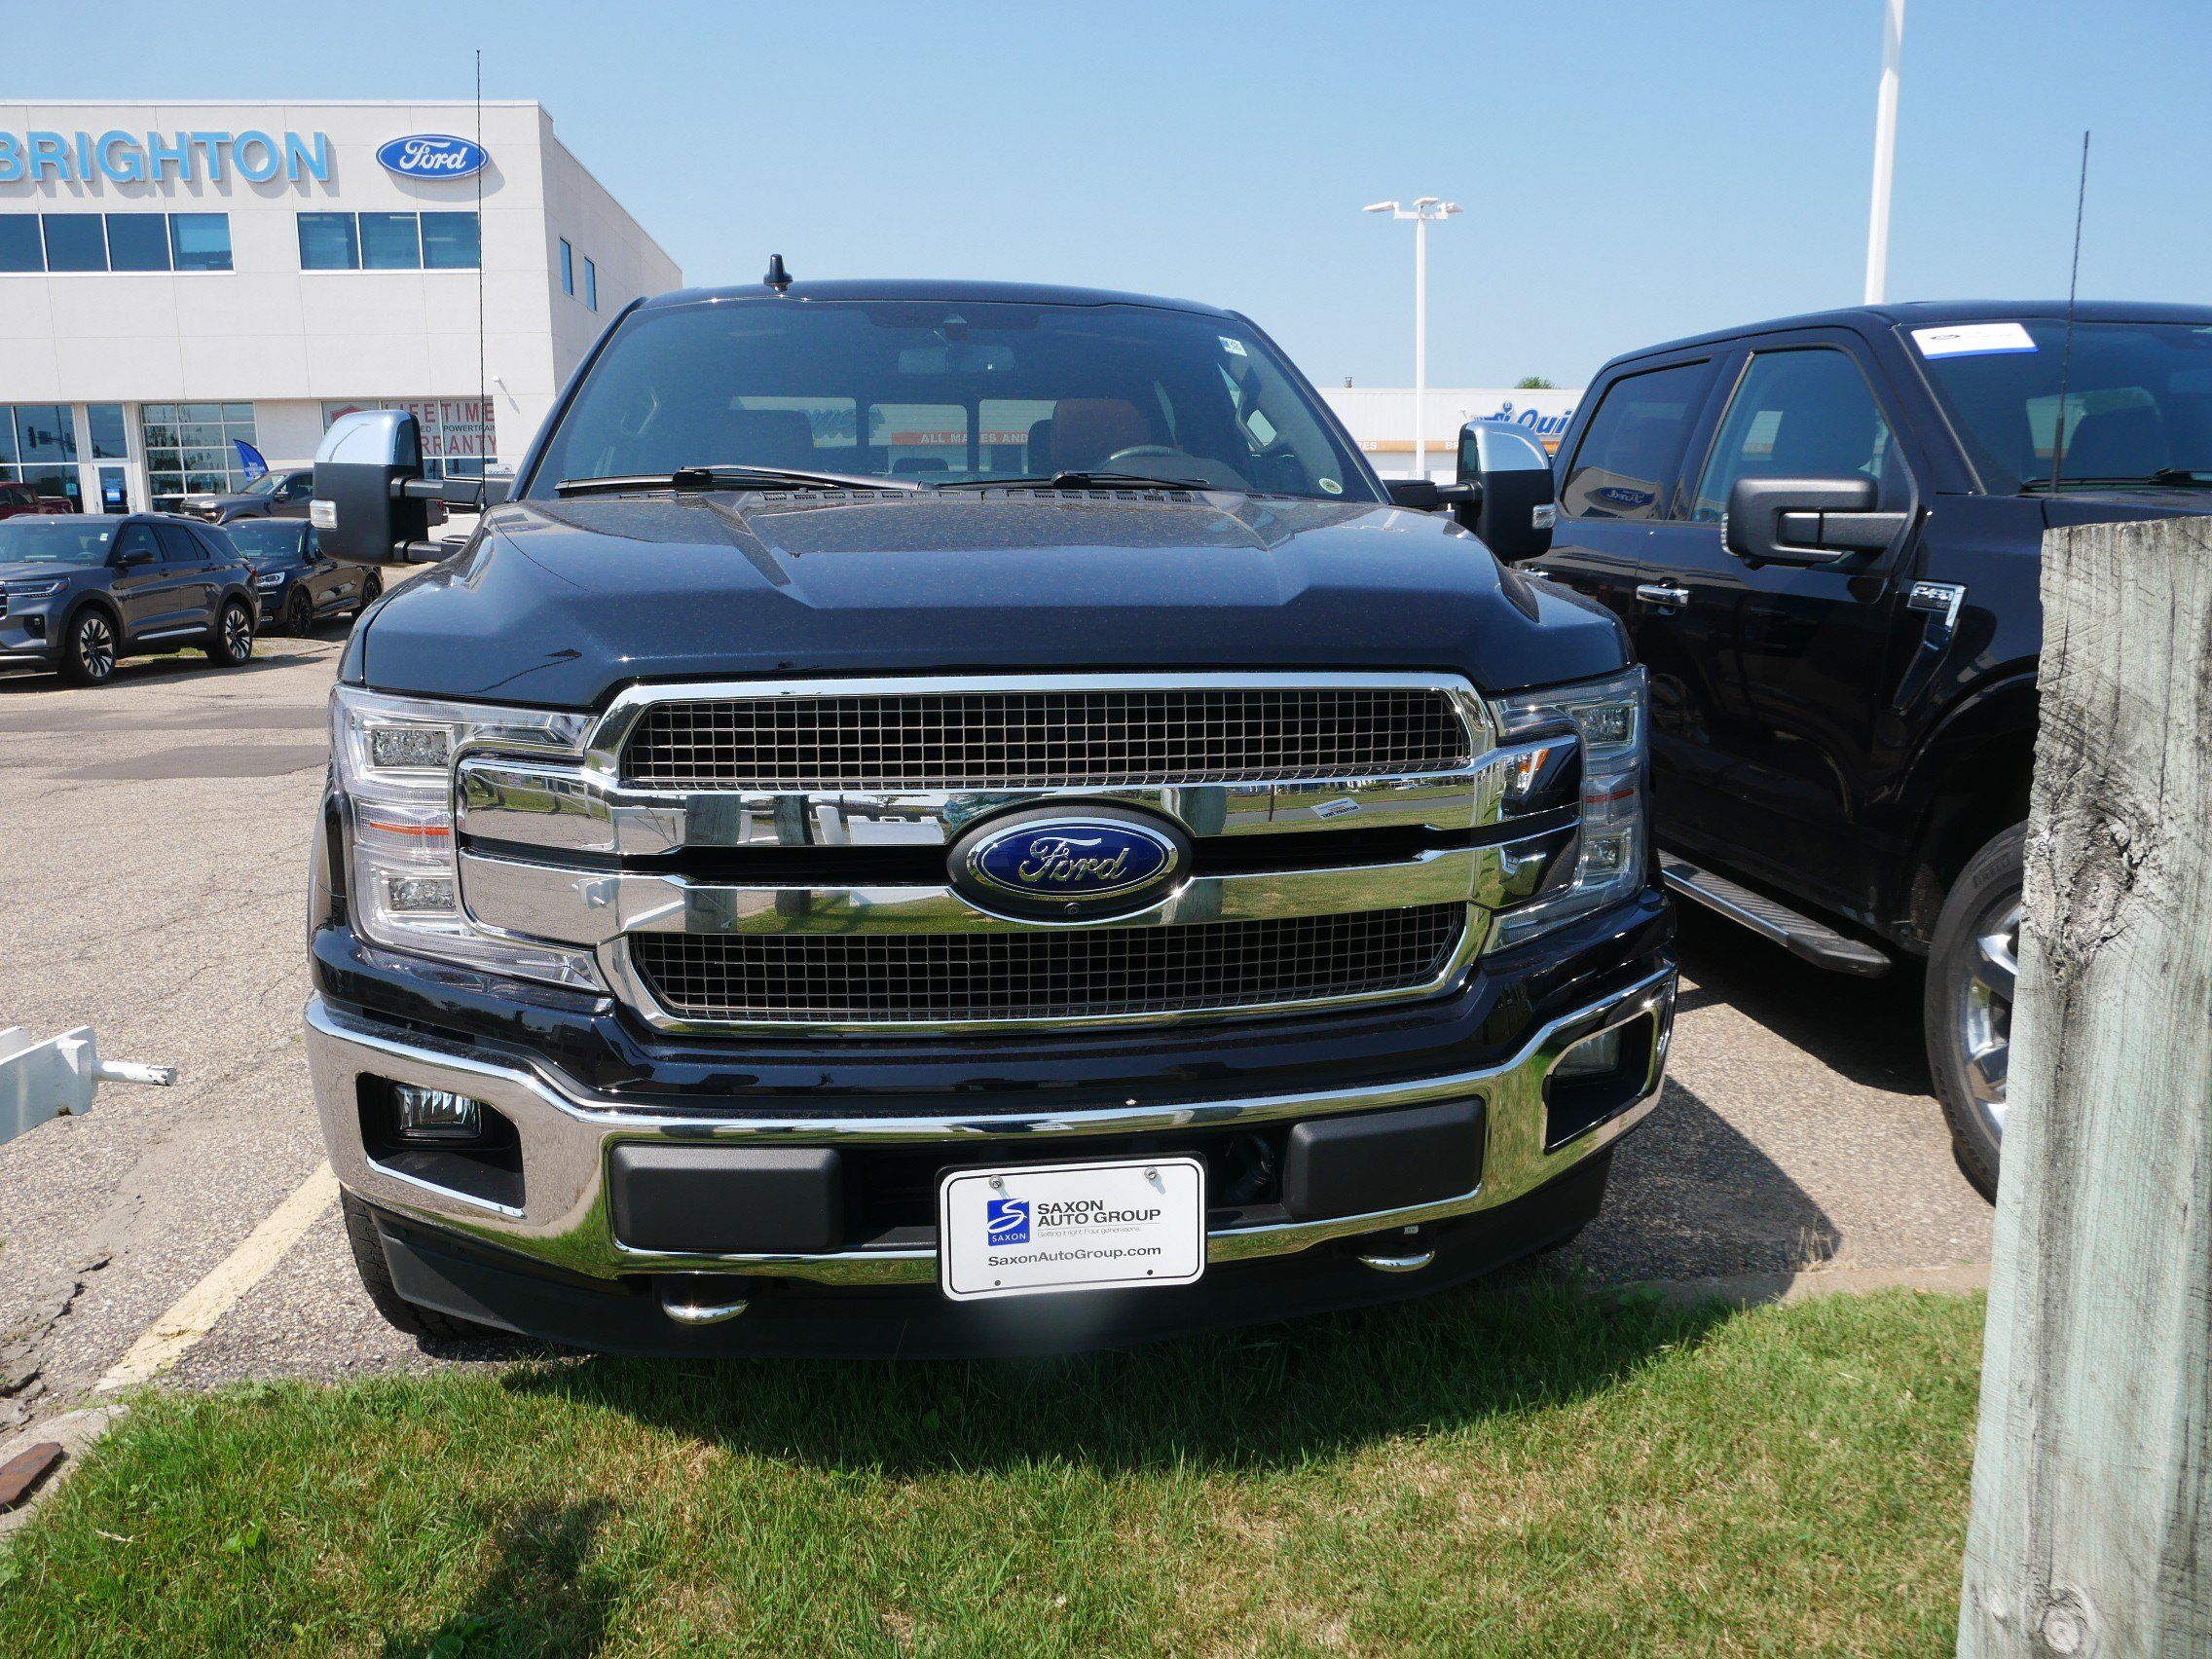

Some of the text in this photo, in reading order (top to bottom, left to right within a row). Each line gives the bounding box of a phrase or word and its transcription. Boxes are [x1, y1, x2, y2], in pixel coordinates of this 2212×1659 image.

[0, 129, 329, 182] BRIGHTON
[399, 139, 468, 169] Ford
[386, 402, 495, 423] FETIME
[1517, 408, 1572, 435] Qui
[421, 434, 498, 455] RRANTY
[920, 433, 945, 444] ALL
[950, 433, 997, 443] MAES
[1018, 836, 1129, 882] Ford
[1037, 1199, 1104, 1215] SAXON
[1037, 1208, 1161, 1228] AUTO GROUP
[992, 1233, 1026, 1242] SAXON
[988, 1247, 1161, 1267] SaxonAutoGroup.com
